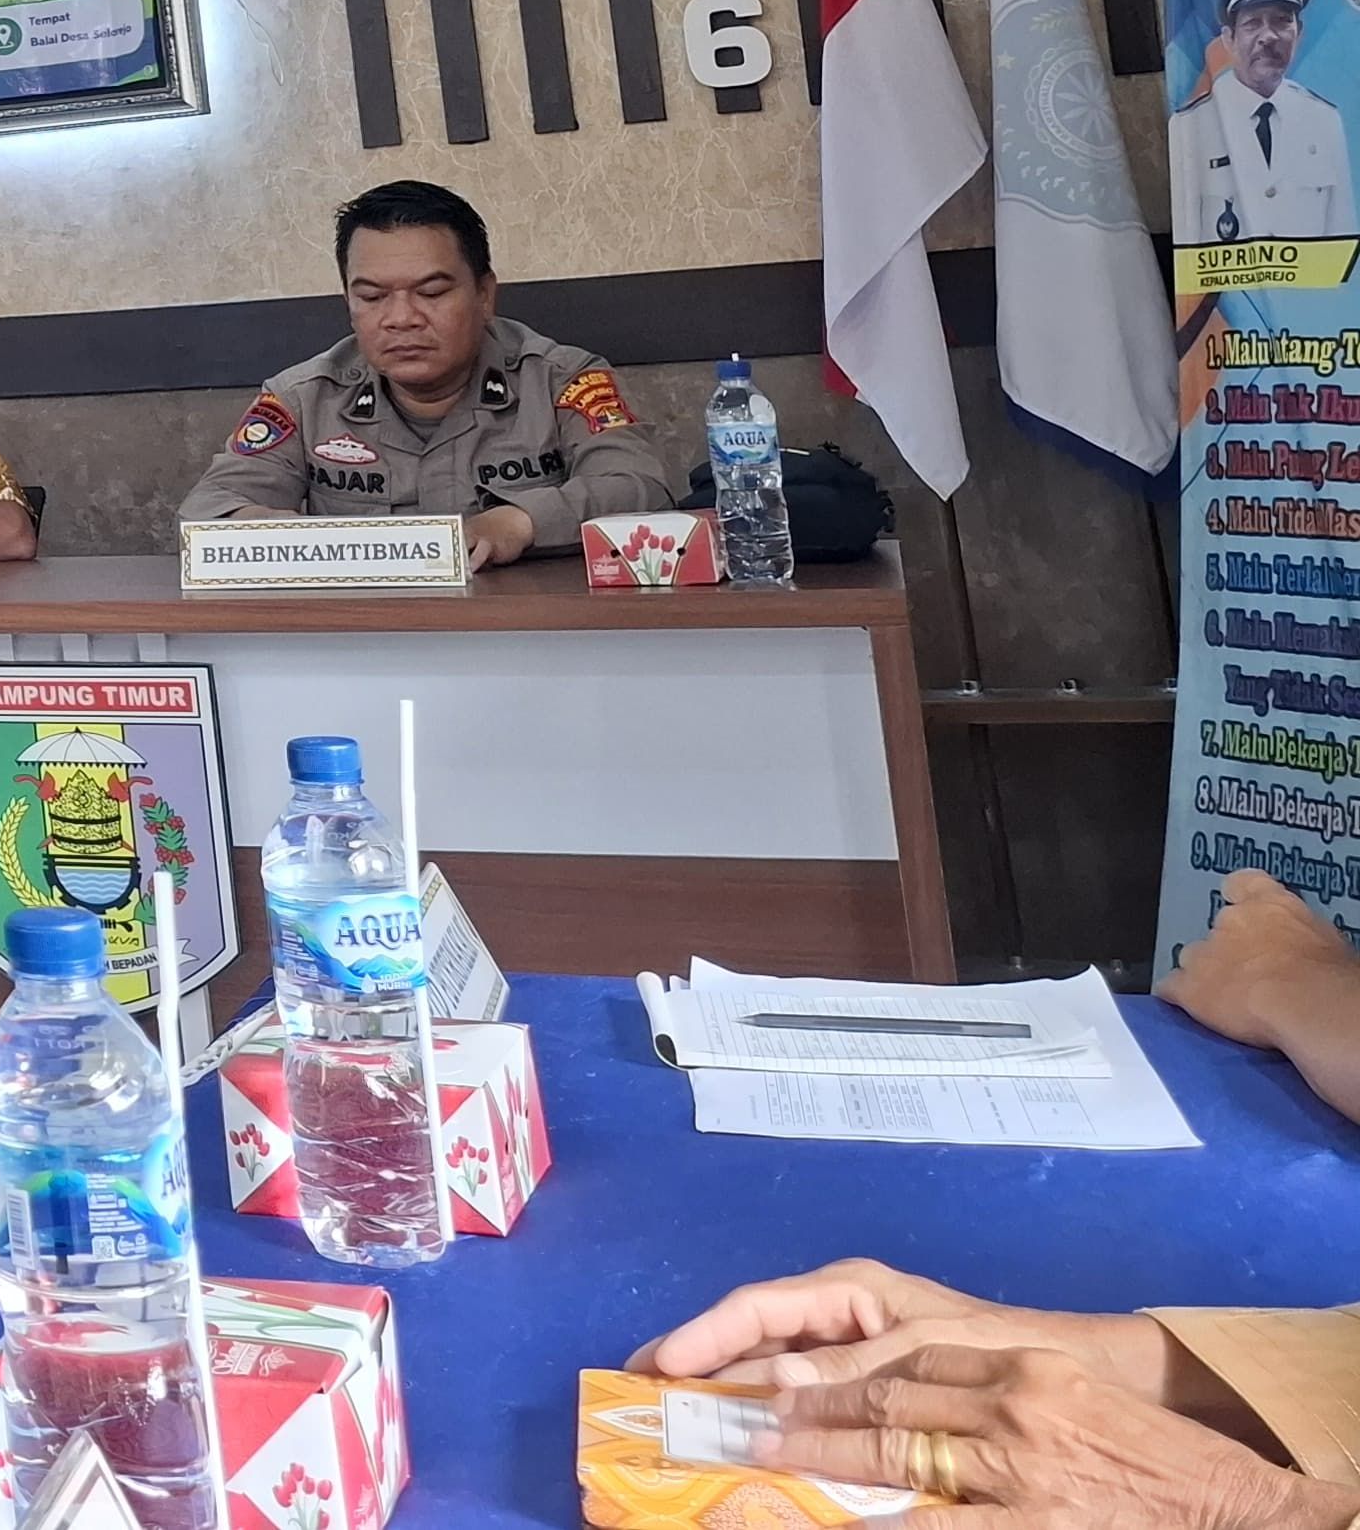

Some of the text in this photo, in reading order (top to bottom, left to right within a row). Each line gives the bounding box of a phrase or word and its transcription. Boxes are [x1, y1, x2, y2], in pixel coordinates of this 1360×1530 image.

[28, 11, 71, 27] Tempat
[30, 33, 59, 47] Balai
[61, 31, 89, 44] Desa
[1232, 274, 1256, 285] DESA
[1223, 330, 1270, 368] Malu
[723, 430, 767, 448] AQUA
[1226, 496, 1273, 536] Malu
[200, 540, 442, 564] BHABINKAMTIBMAS
[1225, 551, 1274, 594] Malu
[105, 683, 186, 706] TIMUR
[1201, 719, 1220, 758] 7.
[1221, 719, 1271, 765] Malu
[1272, 726, 1348, 784] Bekerja
[1195, 775, 1215, 814] 8.
[1218, 776, 1270, 822] Malu
[1270, 784, 1347, 844] Bekerja
[1191, 831, 1212, 870] 9.
[1268, 842, 1346, 904] Bekerja
[335, 911, 422, 951] AQUA
